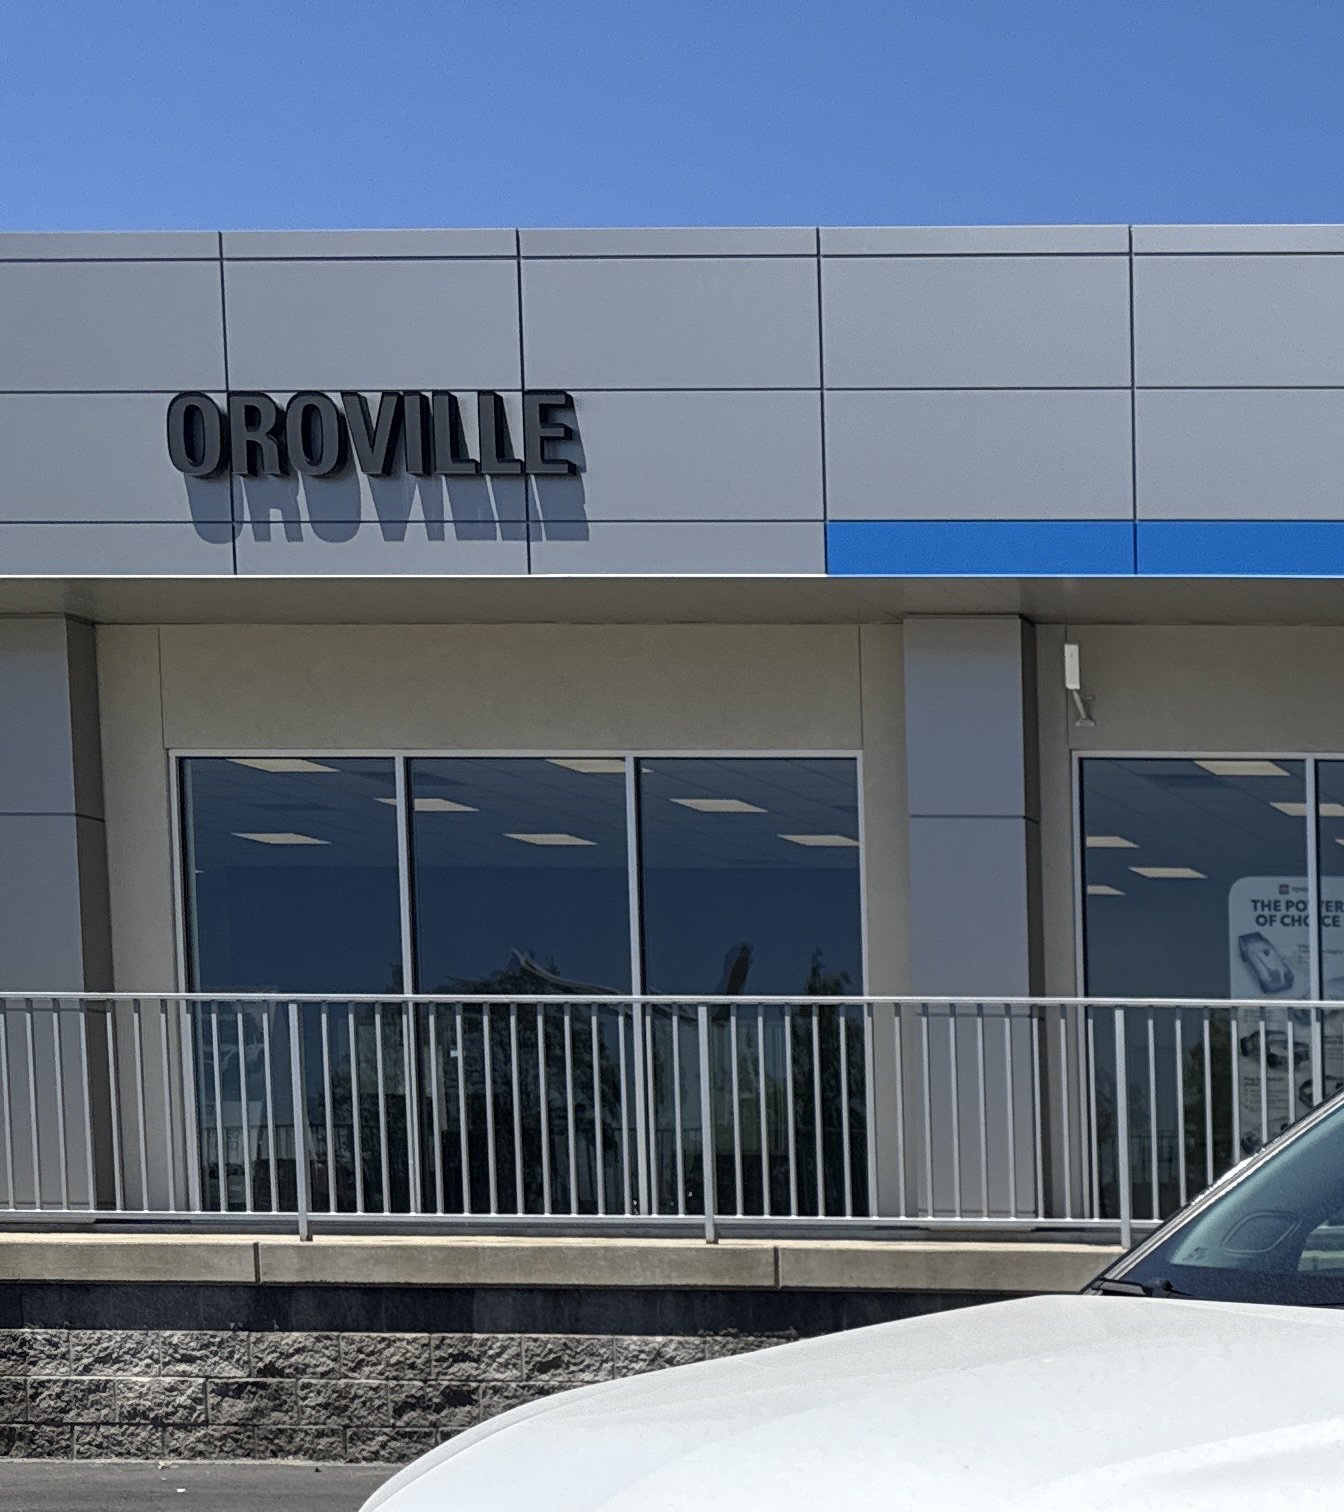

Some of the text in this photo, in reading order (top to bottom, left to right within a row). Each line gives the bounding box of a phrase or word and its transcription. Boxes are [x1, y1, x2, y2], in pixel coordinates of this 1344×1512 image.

[166, 390, 578, 478] OROVILLE
[1251, 899, 1344, 913] THE POER
[1255, 914, 1341, 928] OF CHCE
